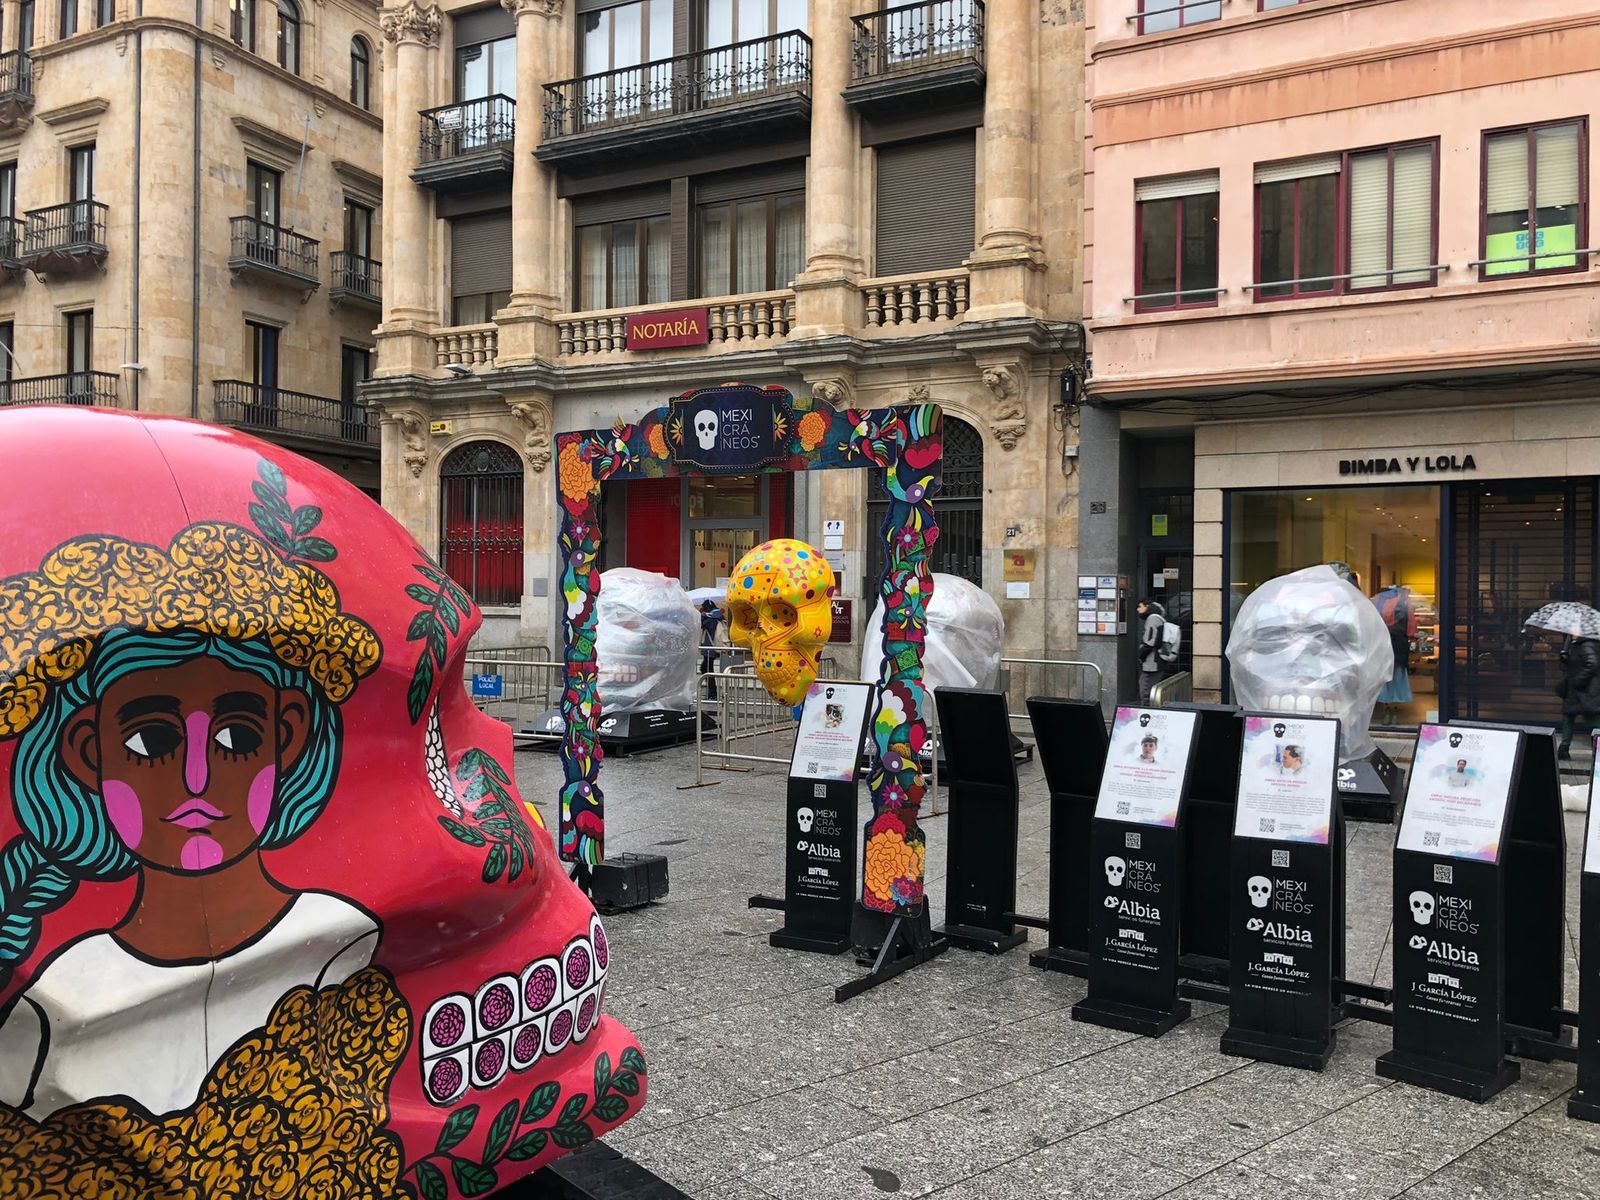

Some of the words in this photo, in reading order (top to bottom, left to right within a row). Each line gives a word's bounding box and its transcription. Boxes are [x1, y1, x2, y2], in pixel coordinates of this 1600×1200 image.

[633, 317, 699, 339] NOTARÍA
[722, 409, 752, 422] MEXI
[722, 421, 750, 436] CRÁ
[723, 437, 759, 449] NEOS
[1339, 458, 1401, 474] BIMBA
[1406, 457, 1420, 471] Y
[1425, 455, 1476, 471] LOLA
[1007, 528, 1015, 536] 21
[816, 810, 837, 818] MEXI
[816, 827, 840, 835] NEOS
[808, 843, 841, 858] Albia
[1129, 860, 1155, 872] MEXI
[1129, 870, 1153, 881] CRÁ
[1128, 880, 1160, 892] NEOS
[1276, 879, 1307, 892] MEXI
[1275, 890, 1304, 902] CRÁ
[1118, 900, 1160, 919] Albia
[1275, 902, 1312, 914] NEOS
[1439, 896, 1471, 910] MEXI
[1439, 908, 1468, 921] CRÁ
[1263, 922, 1312, 942] Albia
[1439, 919, 1478, 934] NEOS
[1427, 940, 1479, 965] Albia
[1427, 957, 1450, 966] servicios
[1452, 961, 1479, 971] funerarios
[1285, 968, 1309, 978] LÓPEZ
[1451, 990, 1477, 1003] LÓPEZ
